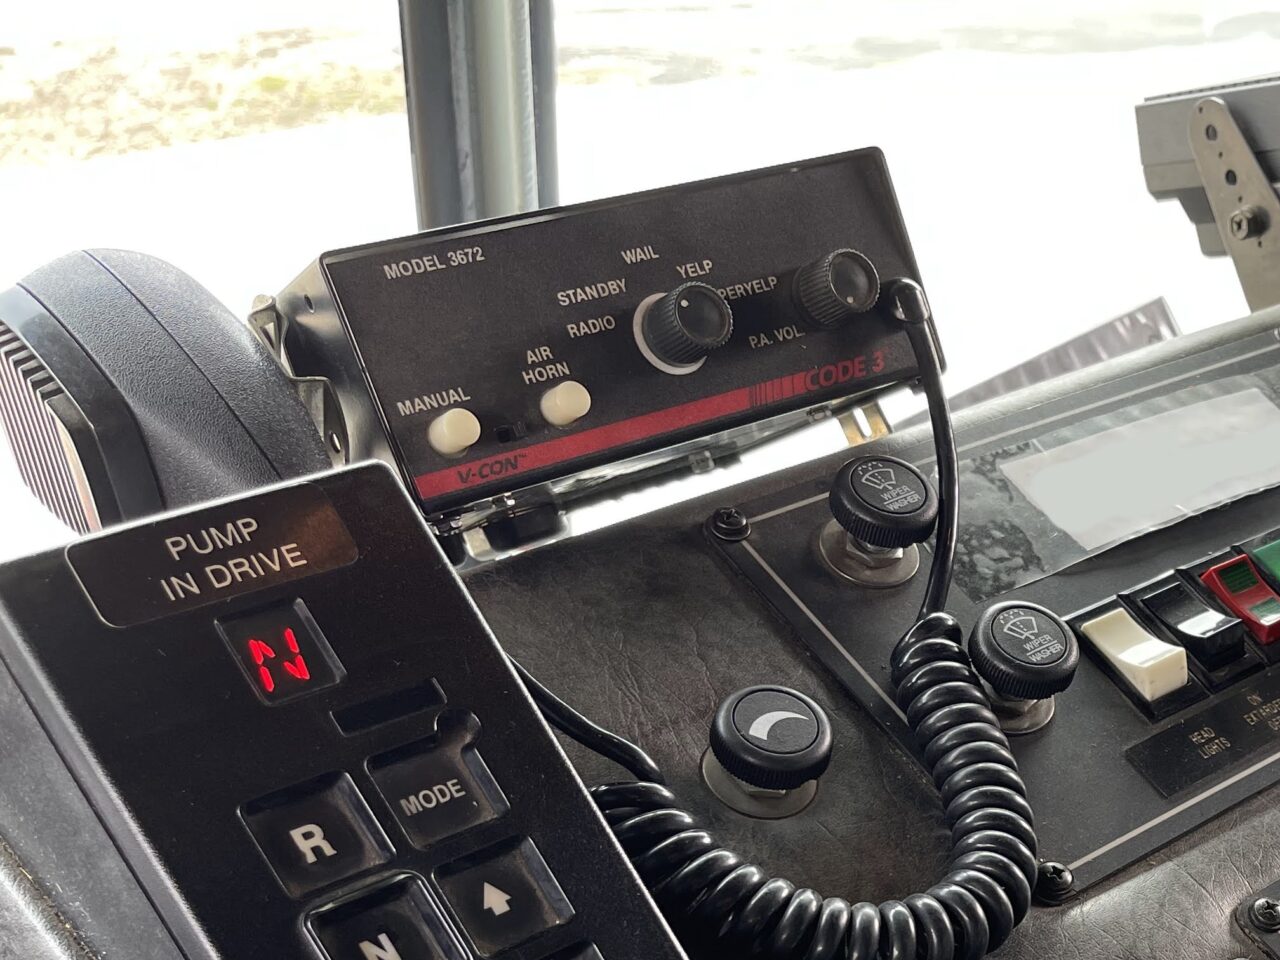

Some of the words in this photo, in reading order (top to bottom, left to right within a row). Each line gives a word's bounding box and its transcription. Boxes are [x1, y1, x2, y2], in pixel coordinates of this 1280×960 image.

[384, 254, 446, 280] MODEL
[448, 247, 486, 267] 3672
[621, 246, 659, 265] WAIL
[677, 260, 713, 279] YELP
[557, 278, 628, 306] STANDBY
[718, 276, 778, 301] PERYELP
[567, 315, 616, 338] RADIO
[749, 334, 774, 350] P.A.
[526, 346, 553, 364] AIR
[522, 361, 570, 384] HORN
[804, 356, 866, 392] CODE
[872, 354, 885, 374] 3
[396, 387, 471, 416] MANUAL
[881, 485, 911, 501] WIPER
[885, 493, 922, 511] WASHER
[165, 518, 258, 561] PUMP
[160, 572, 201, 601] IN
[205, 543, 307, 588] DRIVE
[1023, 634, 1054, 651] WIPER
[1029, 643, 1064, 662] WASHER
[1188, 727, 1216, 745] HEAD
[1200, 738, 1231, 759] LIGHTS
[400, 779, 466, 816] MODE
[289, 823, 337, 864] R
